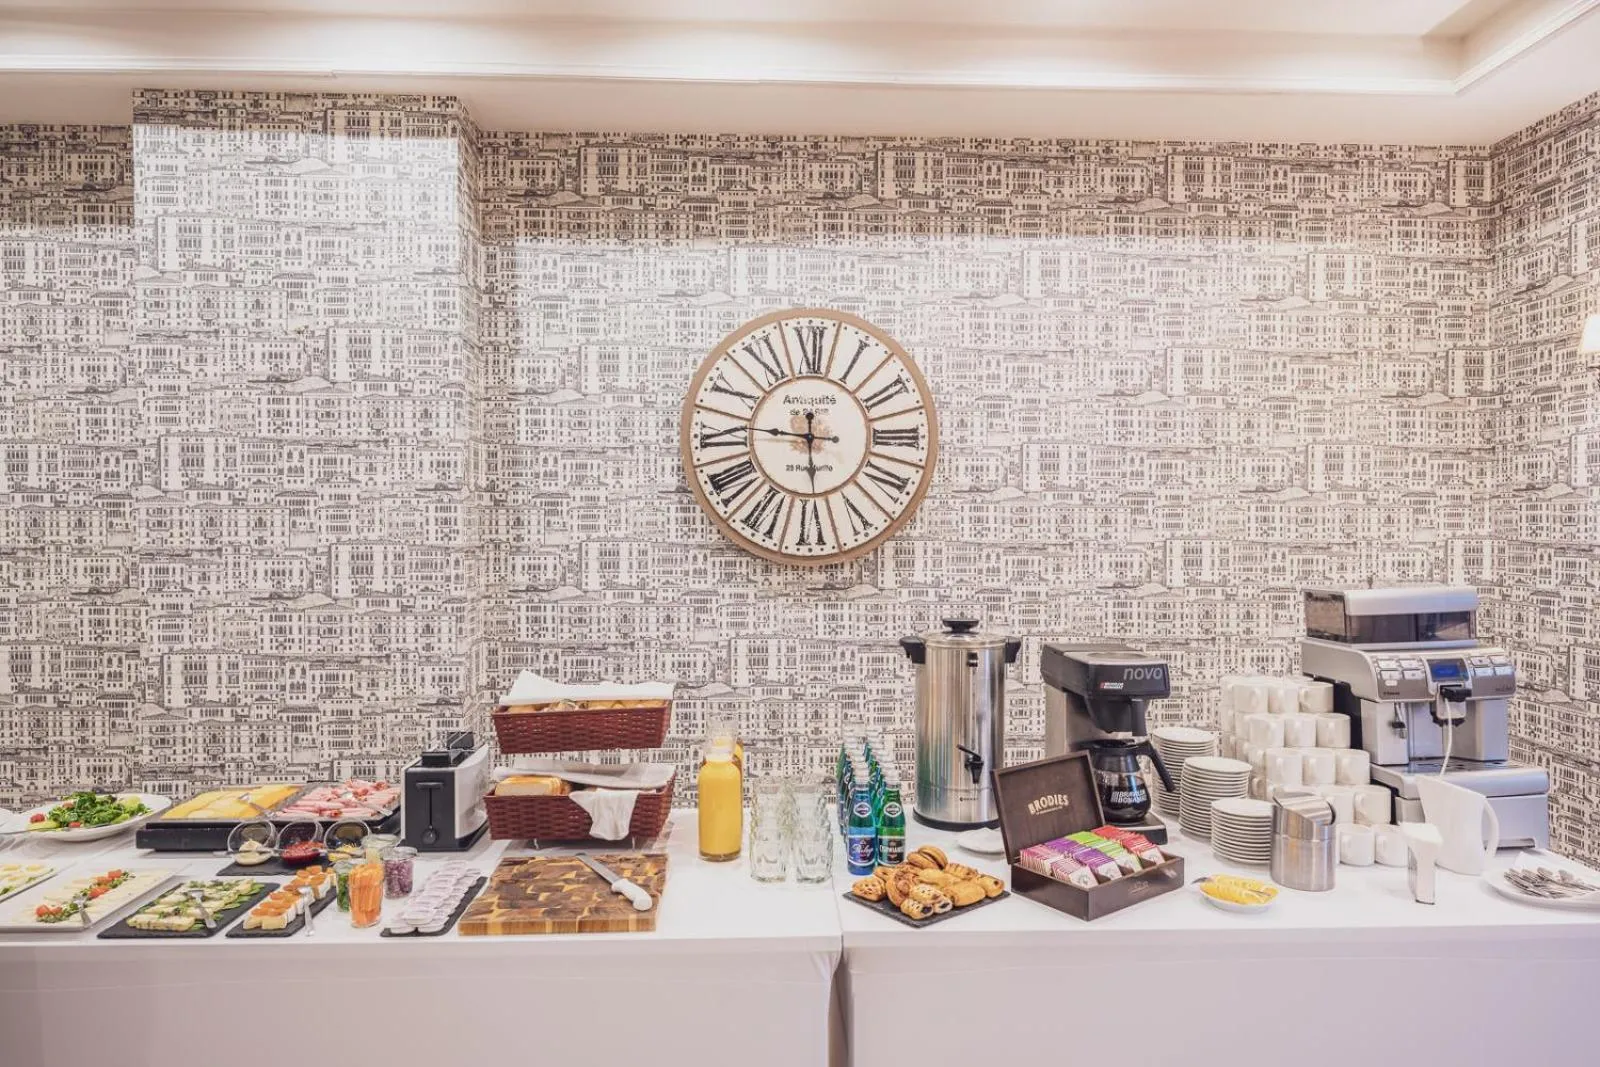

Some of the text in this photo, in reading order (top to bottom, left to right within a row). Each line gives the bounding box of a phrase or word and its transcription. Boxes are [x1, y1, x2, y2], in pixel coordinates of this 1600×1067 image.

[742, 333, 788, 387] XI
[793, 326, 827, 374] XII
[840, 339, 870, 384] I
[710, 370, 760, 412] X
[860, 374, 909, 413] II
[700, 421, 748, 451] IX
[872, 425, 919, 450] III
[707, 456, 760, 508] VIII
[862, 459, 911, 504] IV
[740, 485, 786, 539] VII
[796, 499, 826, 546] VI
[840, 490, 873, 536] V
[1123, 667, 1163, 680] novo
[1028, 794, 1069, 815] BRODIES
